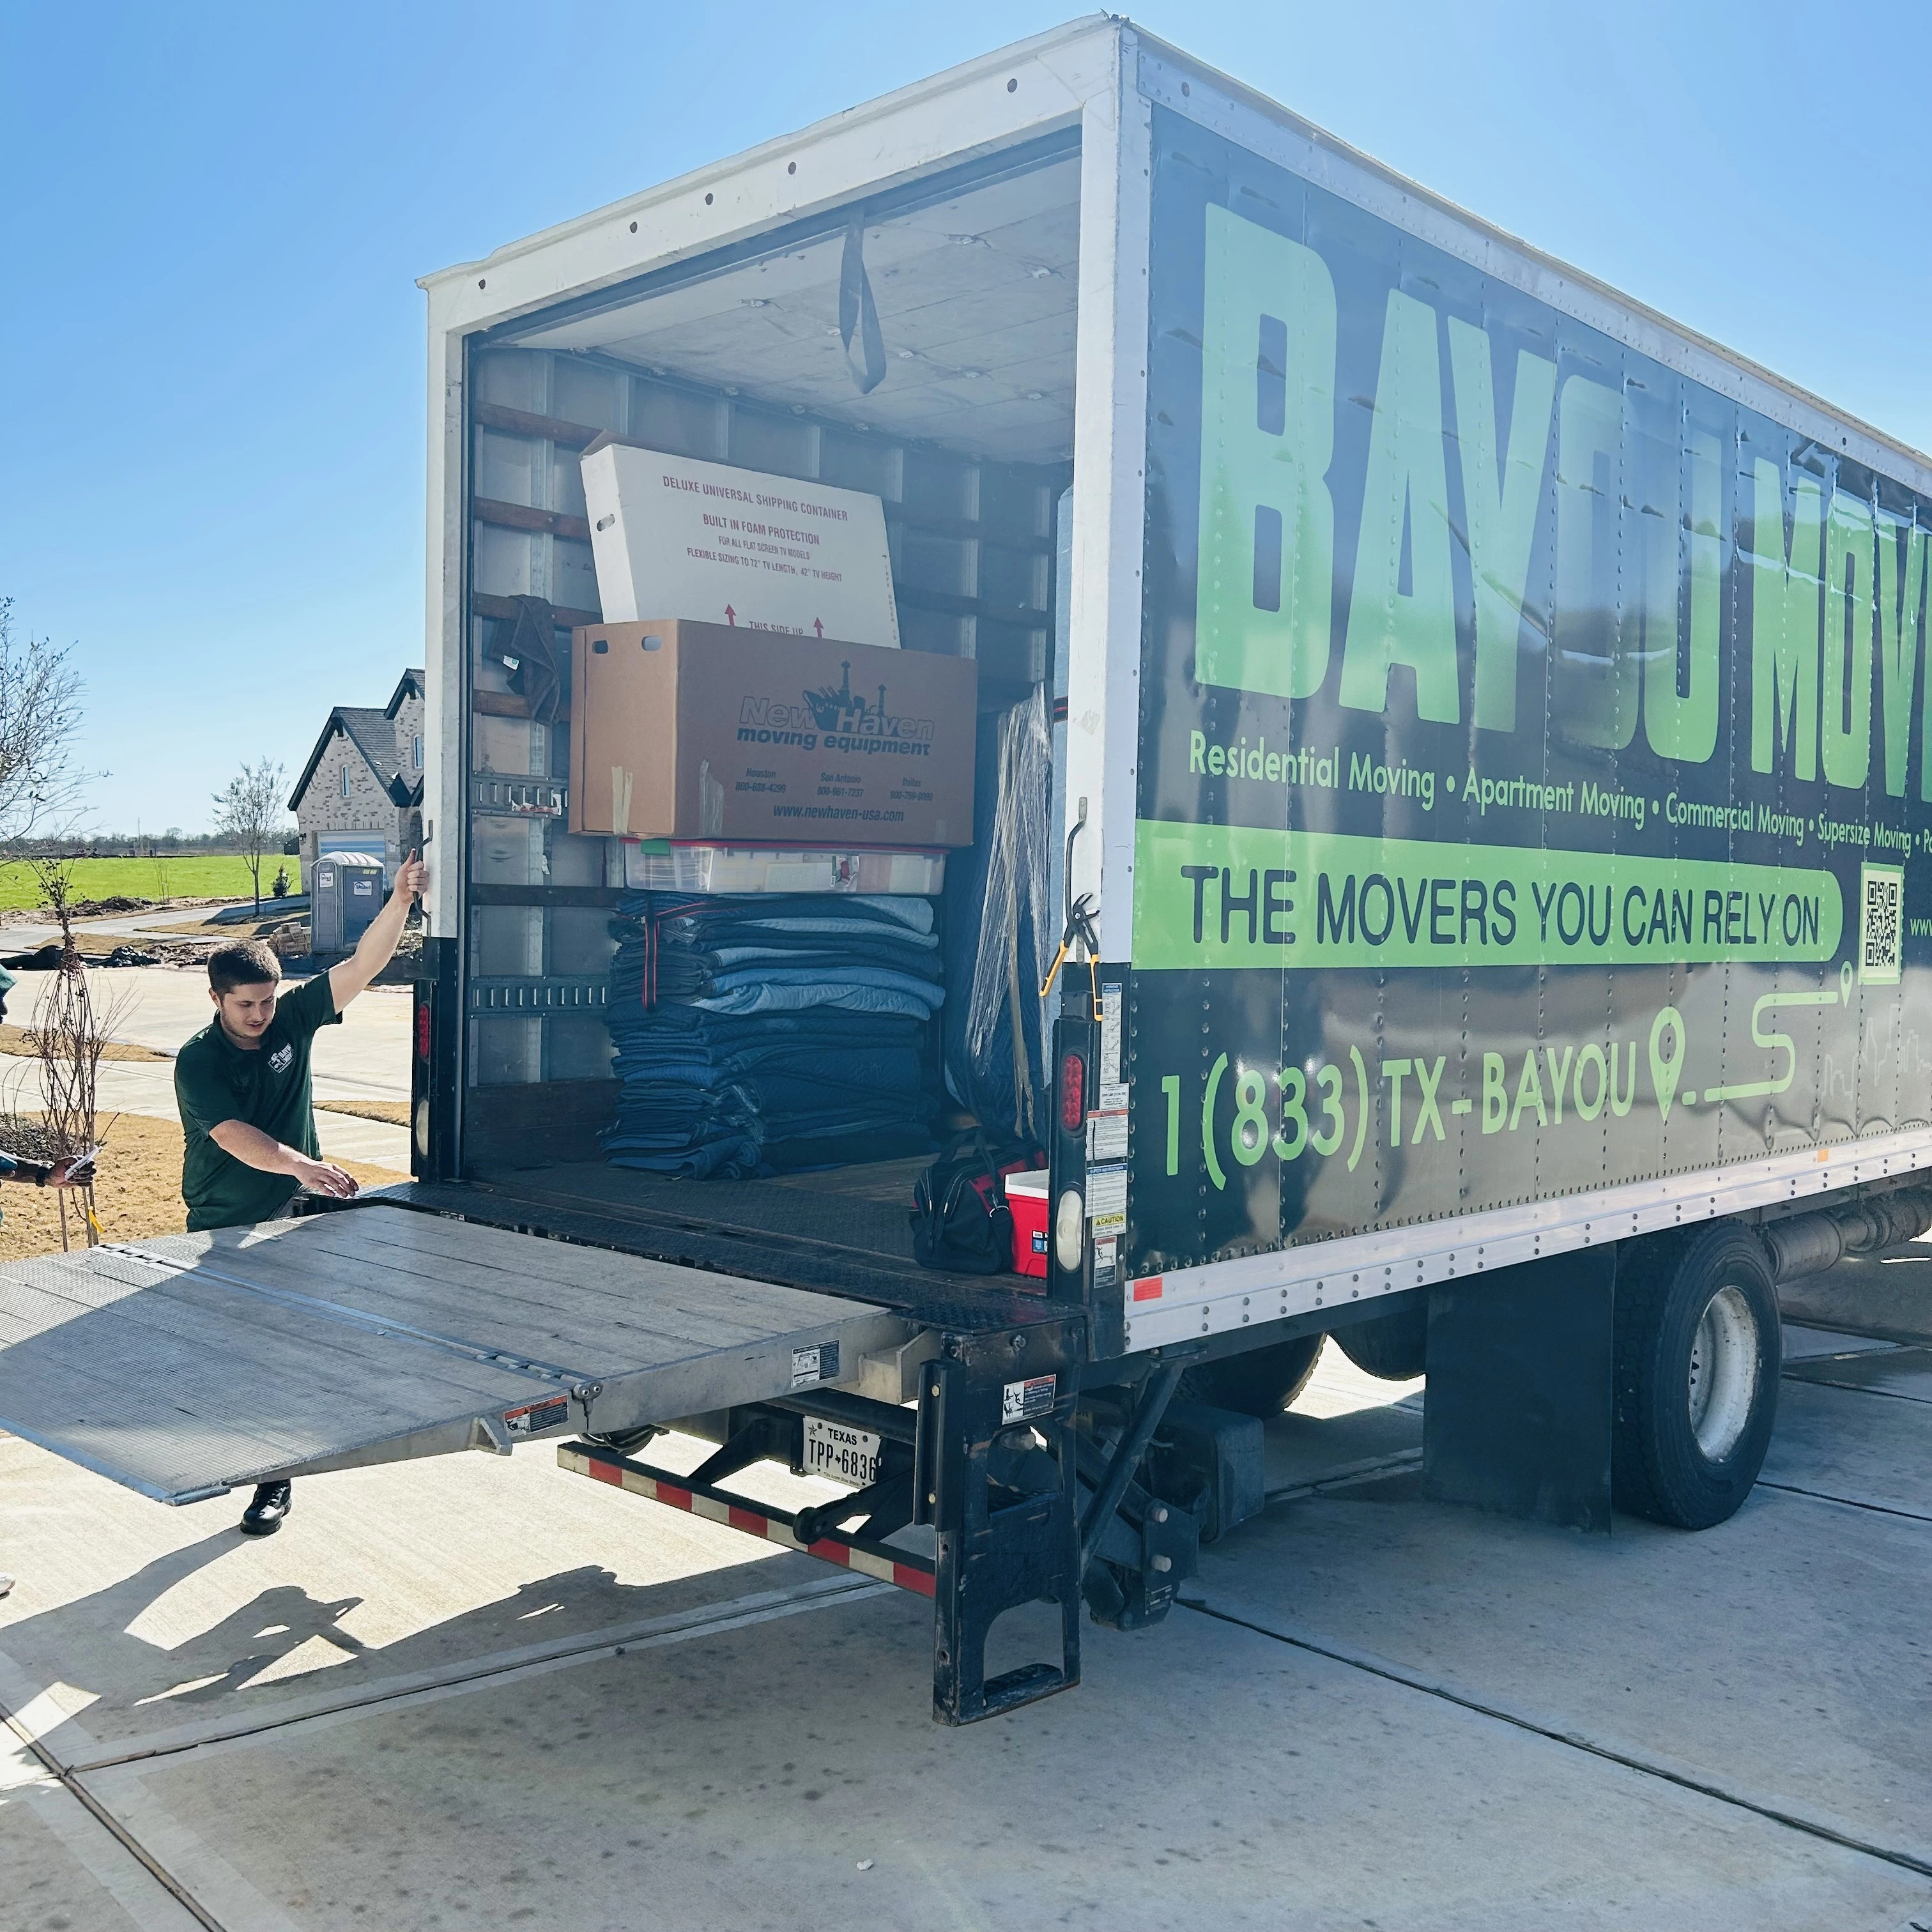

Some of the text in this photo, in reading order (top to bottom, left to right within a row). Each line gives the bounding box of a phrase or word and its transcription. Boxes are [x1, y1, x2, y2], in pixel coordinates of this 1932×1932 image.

[1195, 202, 1721, 763] BAYOU
[663, 476, 848, 521] DELUXE UNIVERSAL SHIPPING CONTAINER
[703, 514, 820, 545] BUILT IN FOAM PROTECTION
[719, 536, 810, 560] FOR ALL FLAT SCREEN TV MODELS
[687, 548, 717, 561] FLEXIBLE
[718, 553, 739, 565] SIZING
[740, 556, 749, 566] TO
[762, 561, 770, 570] TV
[812, 569, 820, 578] TV
[821, 570, 842, 582] HEIGHT
[749, 621, 768, 631] THIS
[739, 696, 935, 740] New Haven
[737, 728, 931, 756] moving equipment
[746, 768, 776, 779] Houston
[820, 773, 861, 783] San Antonio
[1190, 730, 1339, 789] Residential
[1349, 751, 1435, 811] Moving
[1462, 767, 1574, 816] Apartment
[1580, 781, 1645, 831] Moving
[1666, 794, 1753, 832] Commercial
[1758, 804, 1804, 847] Moving
[1818, 813, 1871, 851] Supersize
[1873, 821, 1912, 859] Moving
[773, 805, 904, 822] www.newhaven-usa.com
[1181, 865, 1819, 946] THE MOVERS YOU CAN RELY ON
[1101, 1216, 1124, 1224] CAUTION
[828, 1428, 857, 1445] TEXAS
